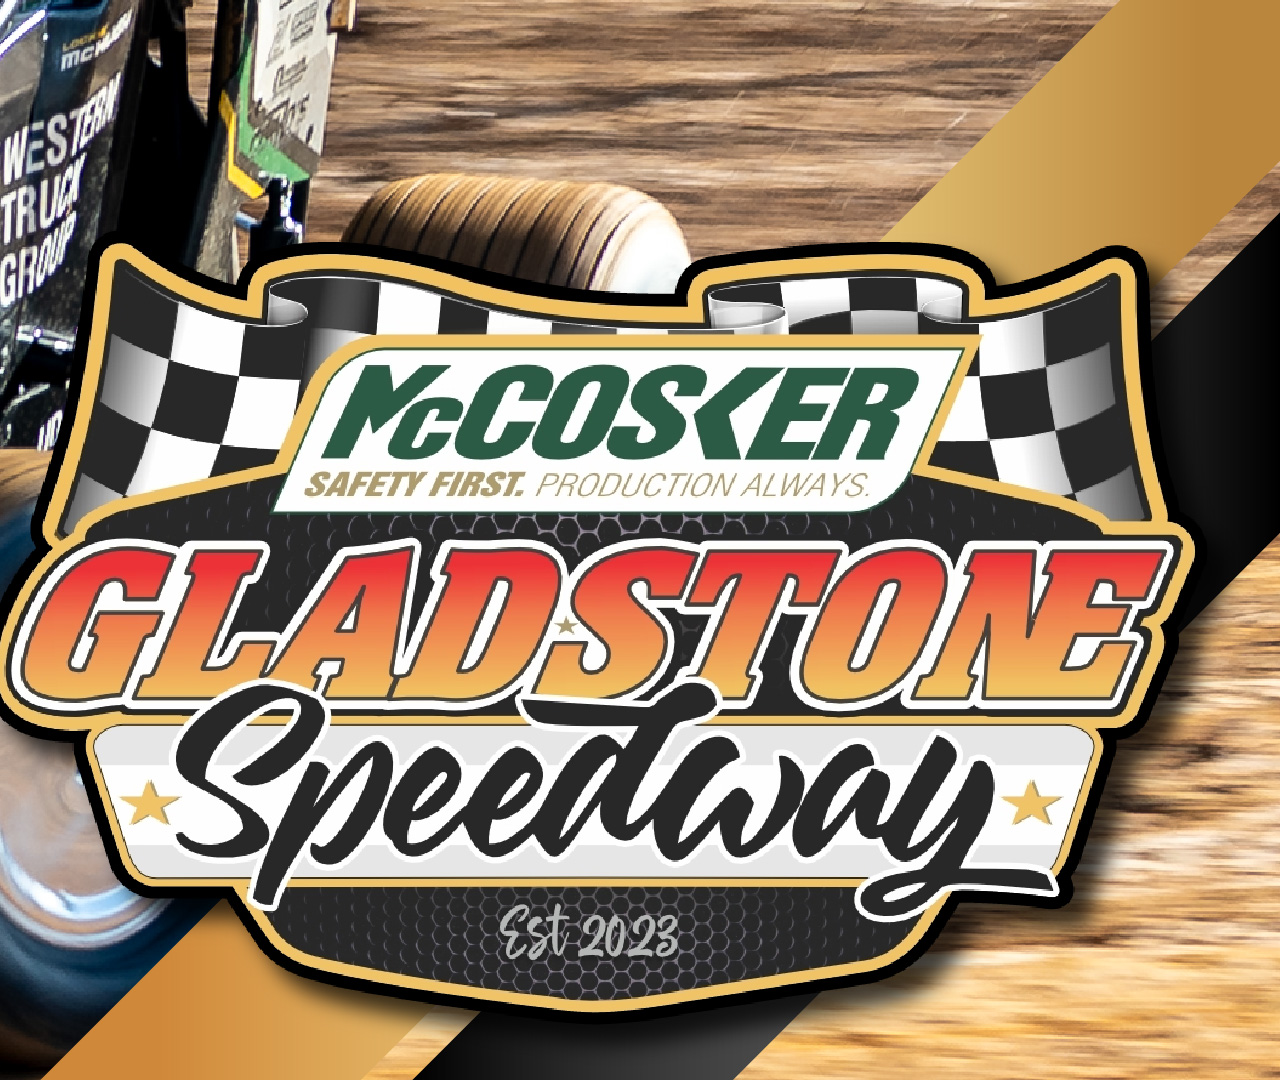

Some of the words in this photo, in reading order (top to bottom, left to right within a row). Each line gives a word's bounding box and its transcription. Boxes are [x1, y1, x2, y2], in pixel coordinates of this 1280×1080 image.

[3, 72, 123, 186] WESTERN
[0, 152, 87, 247] TRUCK
[0, 211, 78, 308] GROUP
